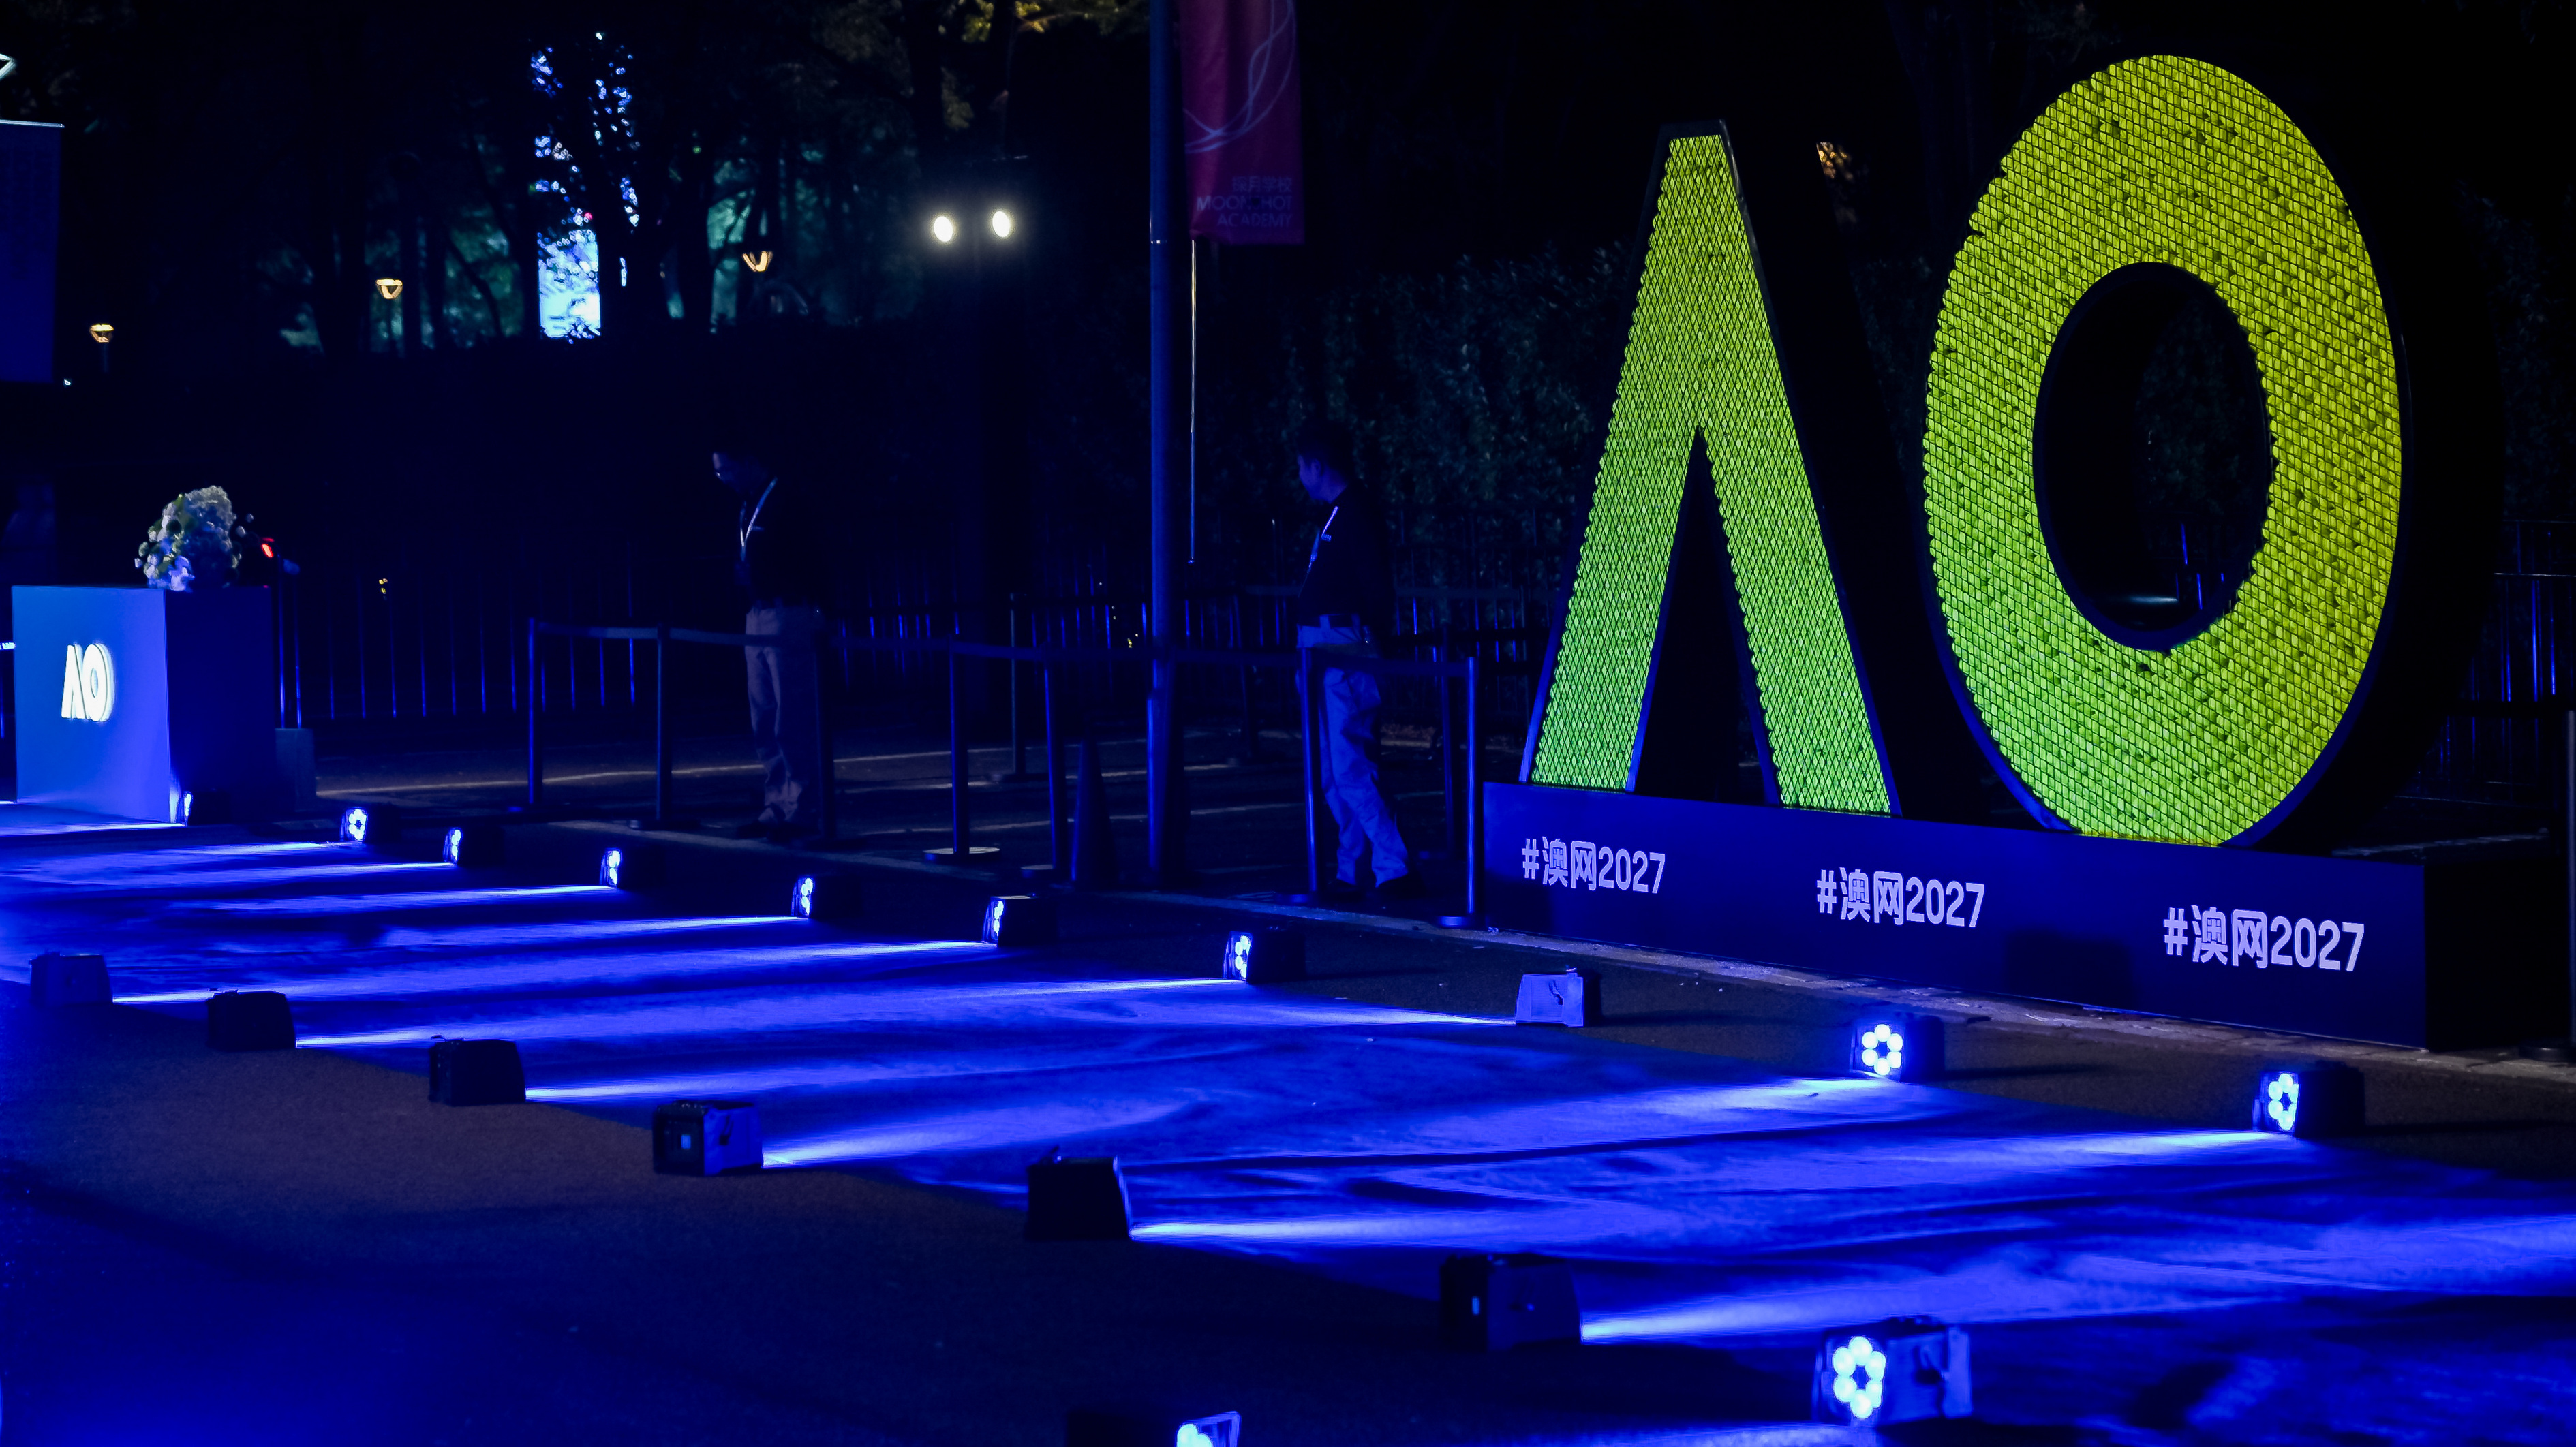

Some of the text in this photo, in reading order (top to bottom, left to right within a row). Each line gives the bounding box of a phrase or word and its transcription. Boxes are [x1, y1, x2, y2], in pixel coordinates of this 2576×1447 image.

[1216, 213, 1293, 228] ACADEMY
[1525, 53, 2403, 847] AO
[61, 644, 113, 722] AO
[1522, 836, 1666, 894] #澳网2027
[1816, 867, 1985, 928] #澳网2027
[2163, 905, 2365, 972] #澳网2027
